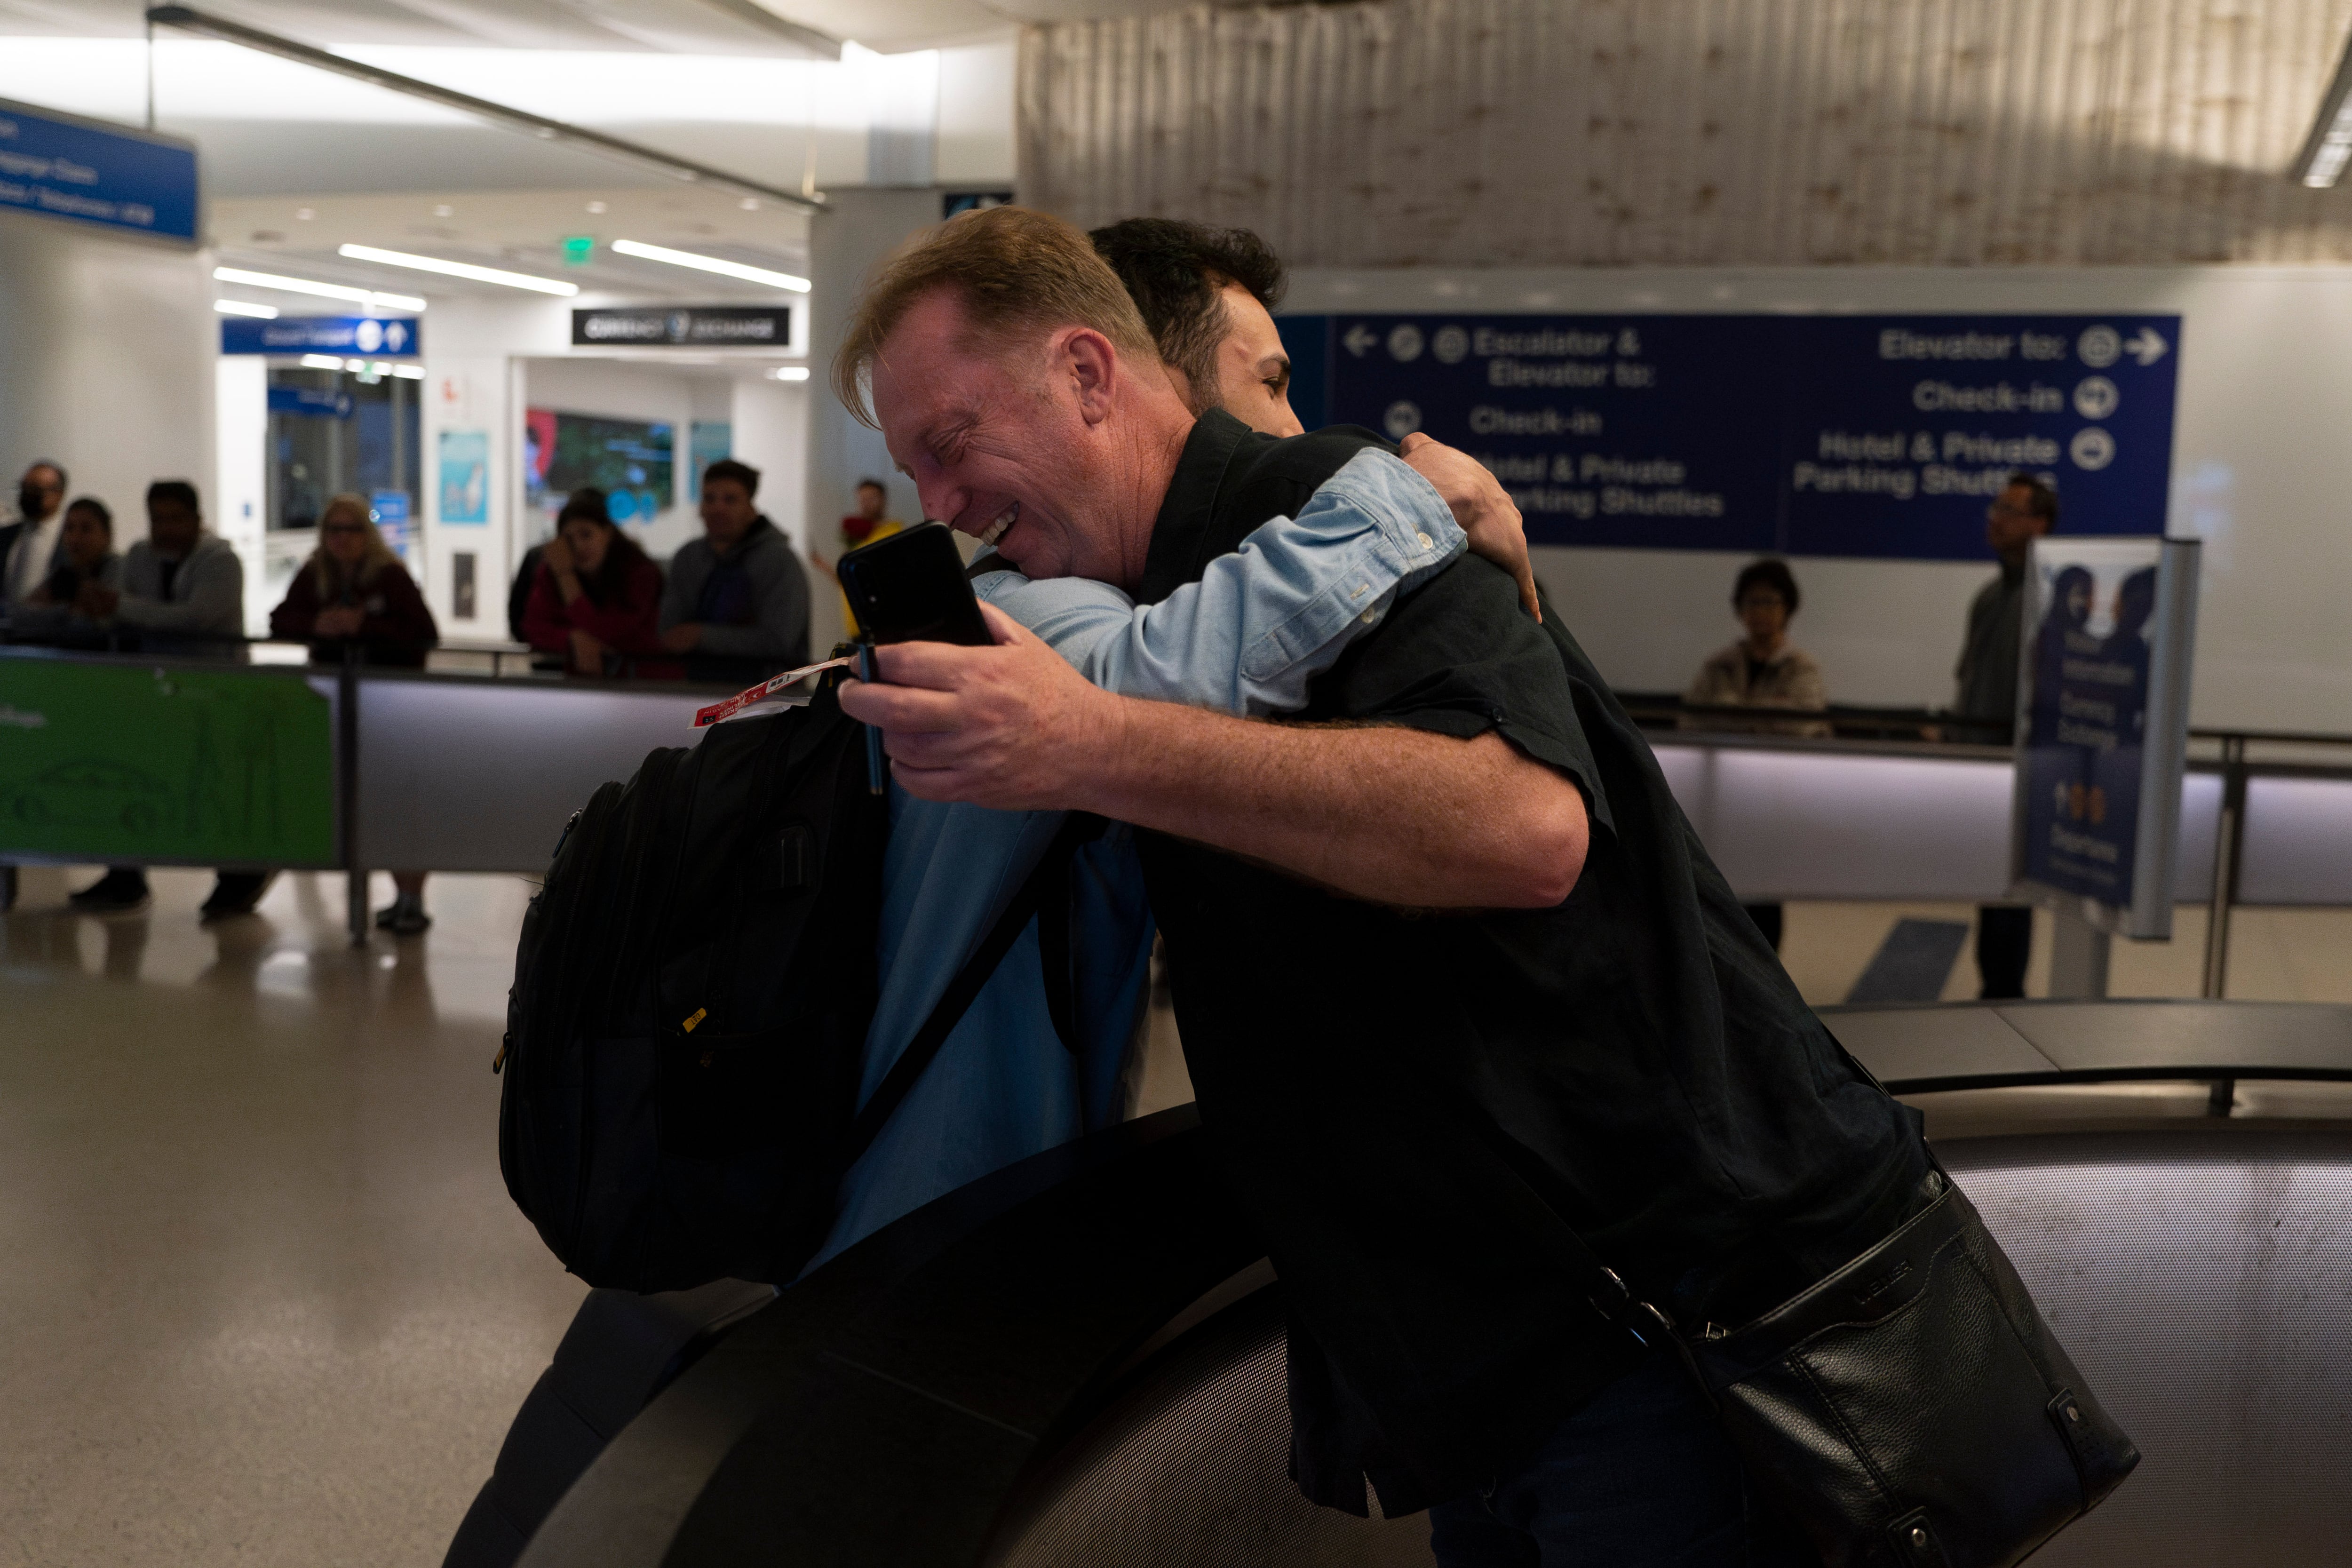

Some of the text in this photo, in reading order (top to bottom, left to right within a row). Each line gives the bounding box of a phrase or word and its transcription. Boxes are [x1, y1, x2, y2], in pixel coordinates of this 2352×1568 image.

[1474, 328, 1641, 357] Escalator &
[1880, 328, 2013, 360] Elevator
[1488, 359, 1608, 387] Elevator
[1913, 380, 2063, 412] Check-in
[1470, 405, 1603, 435] Check-in
[1820, 431, 2059, 463] Hotel & Private
[1551, 453, 1572, 481] &
[1581, 454, 1686, 485] Private
[1794, 462, 1915, 499] Parking
[1511, 486, 1724, 518] arking Shuttles
